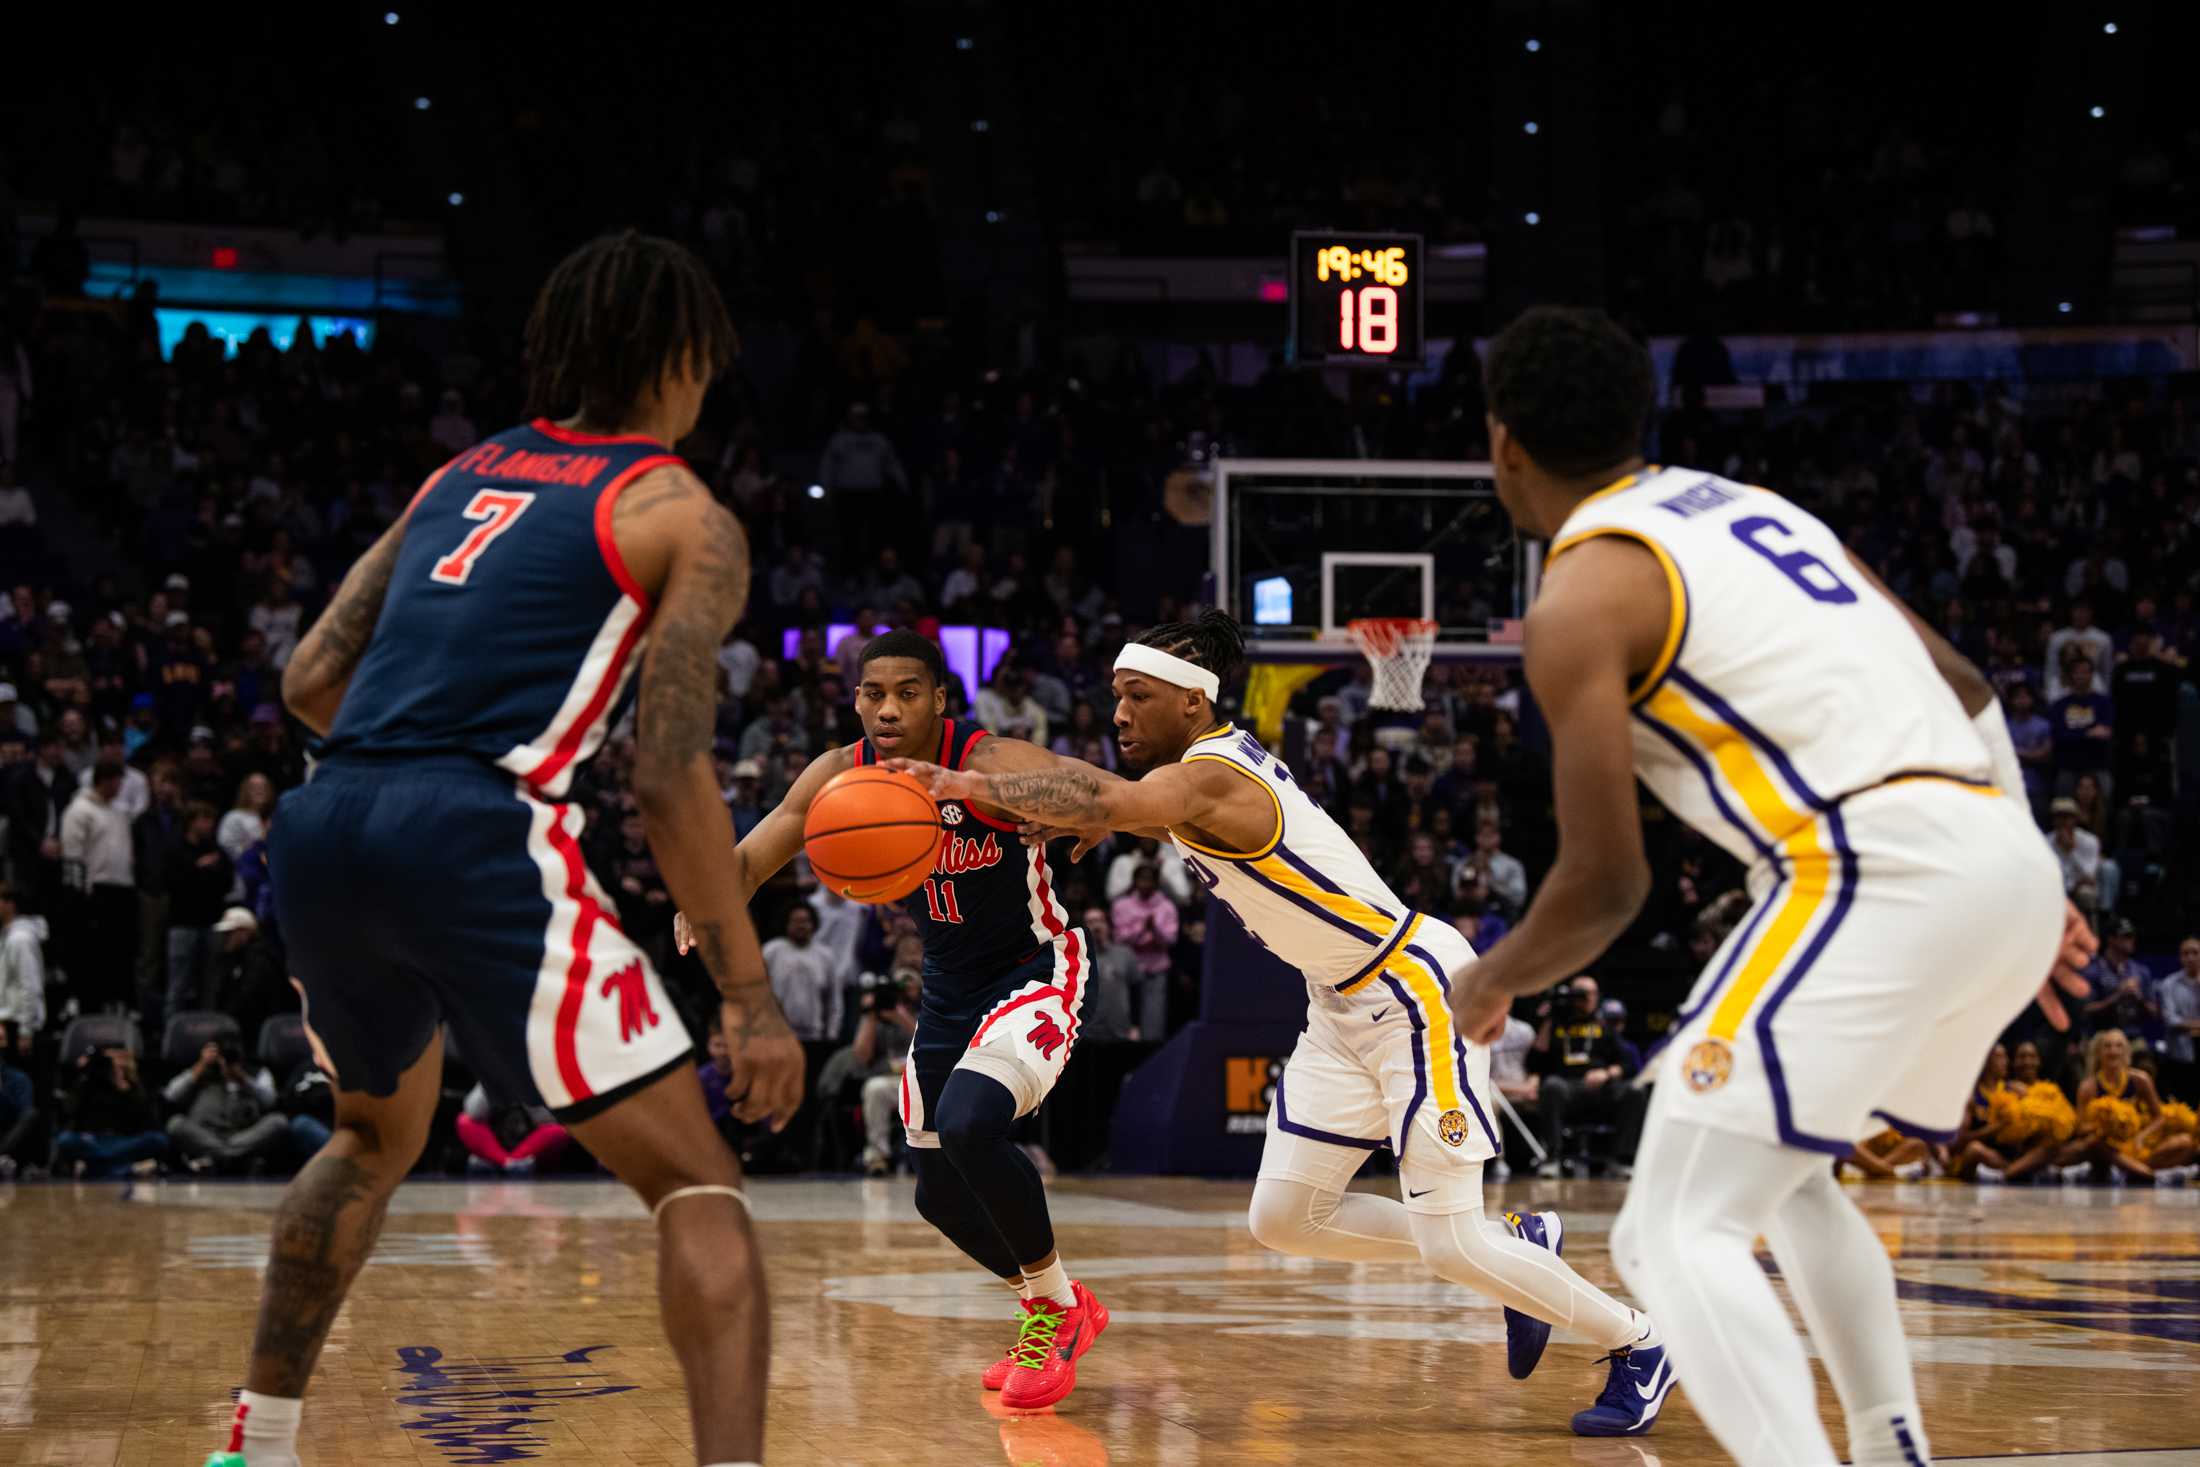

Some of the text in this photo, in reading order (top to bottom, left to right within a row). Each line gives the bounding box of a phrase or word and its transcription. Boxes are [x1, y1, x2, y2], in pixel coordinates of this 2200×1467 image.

[1317, 245, 1409, 287] 19:46
[1340, 286, 1398, 353] 18
[429, 487, 537, 586] 7
[1729, 515, 1859, 605] 6
[940, 803, 963, 826] SEC
[923, 878, 964, 925] 11
